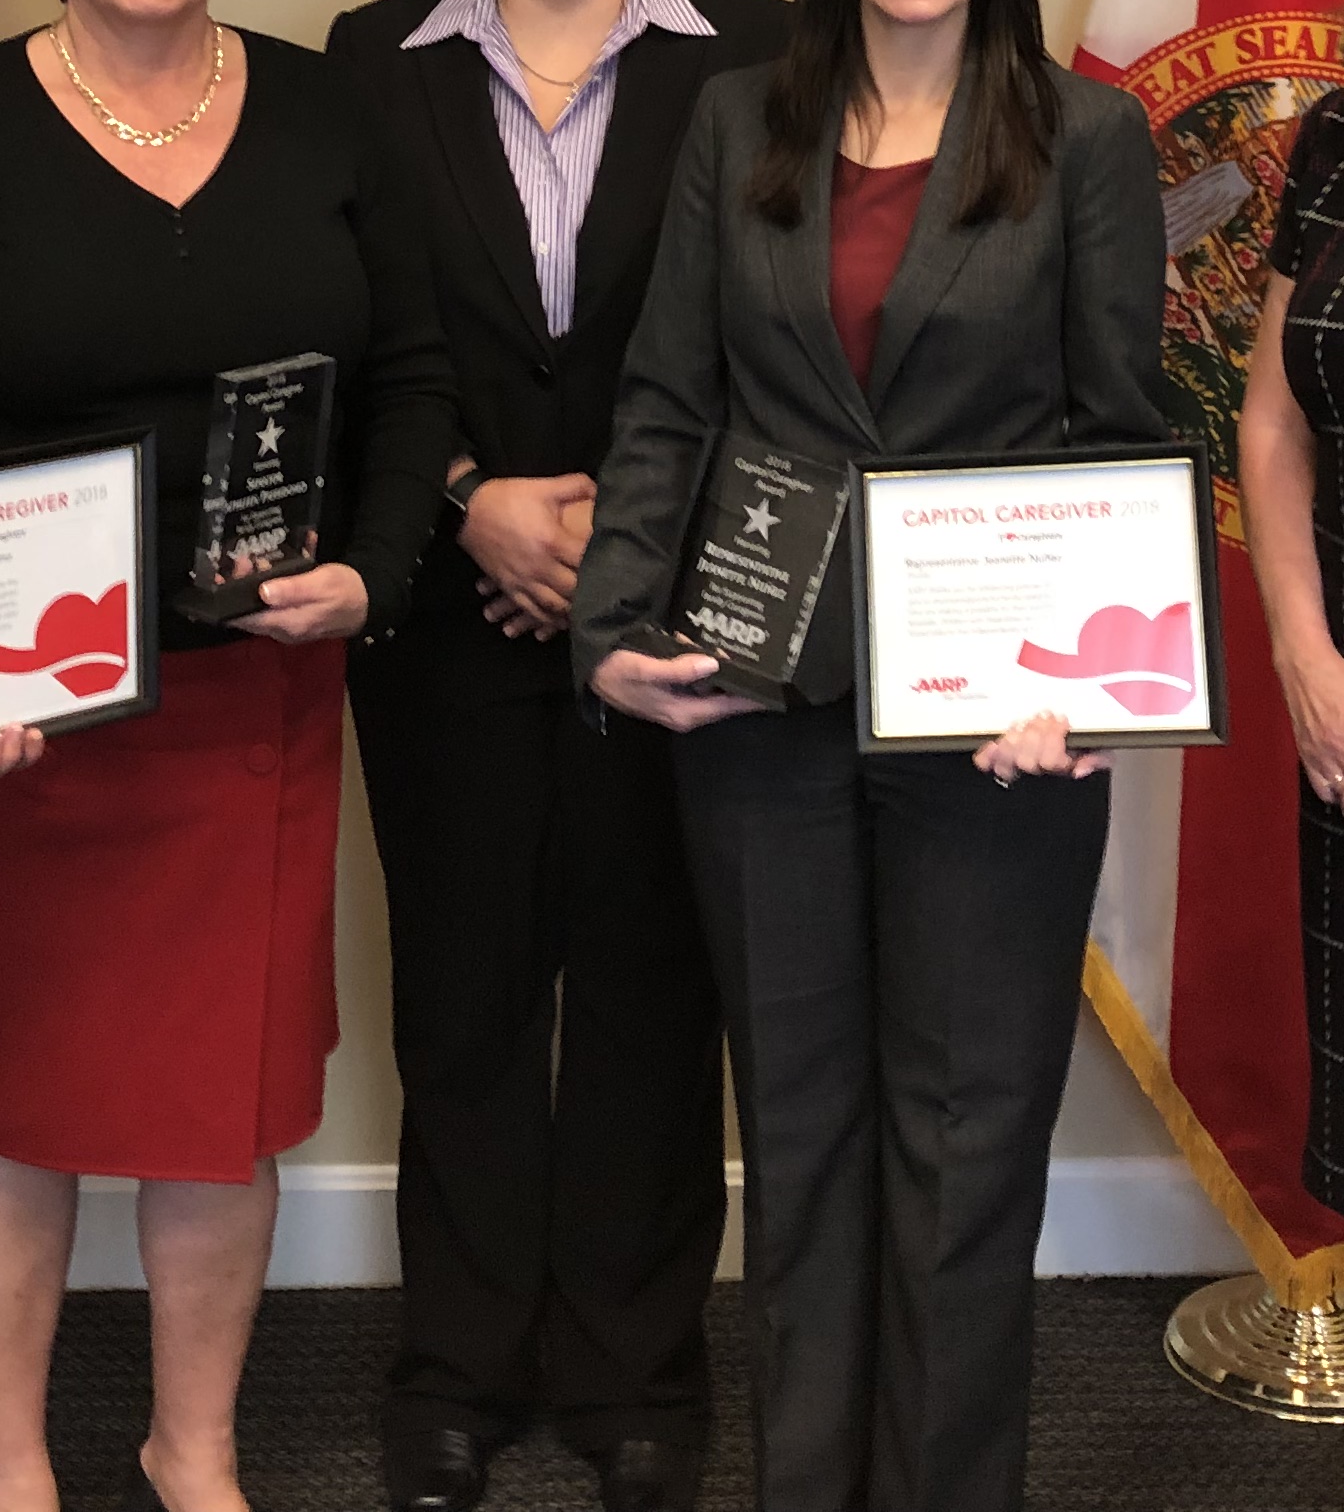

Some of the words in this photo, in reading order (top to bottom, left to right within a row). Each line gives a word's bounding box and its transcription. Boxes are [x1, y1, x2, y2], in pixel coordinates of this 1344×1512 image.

[1132, 41, 1217, 110] EAT
[74, 484, 108, 507] 2018
[902, 507, 989, 528] CAPITOL
[995, 500, 1113, 523] CAREGIVER
[1119, 499, 1160, 517] 2018
[685, 606, 770, 648] AARP
[909, 676, 969, 694] AARP
